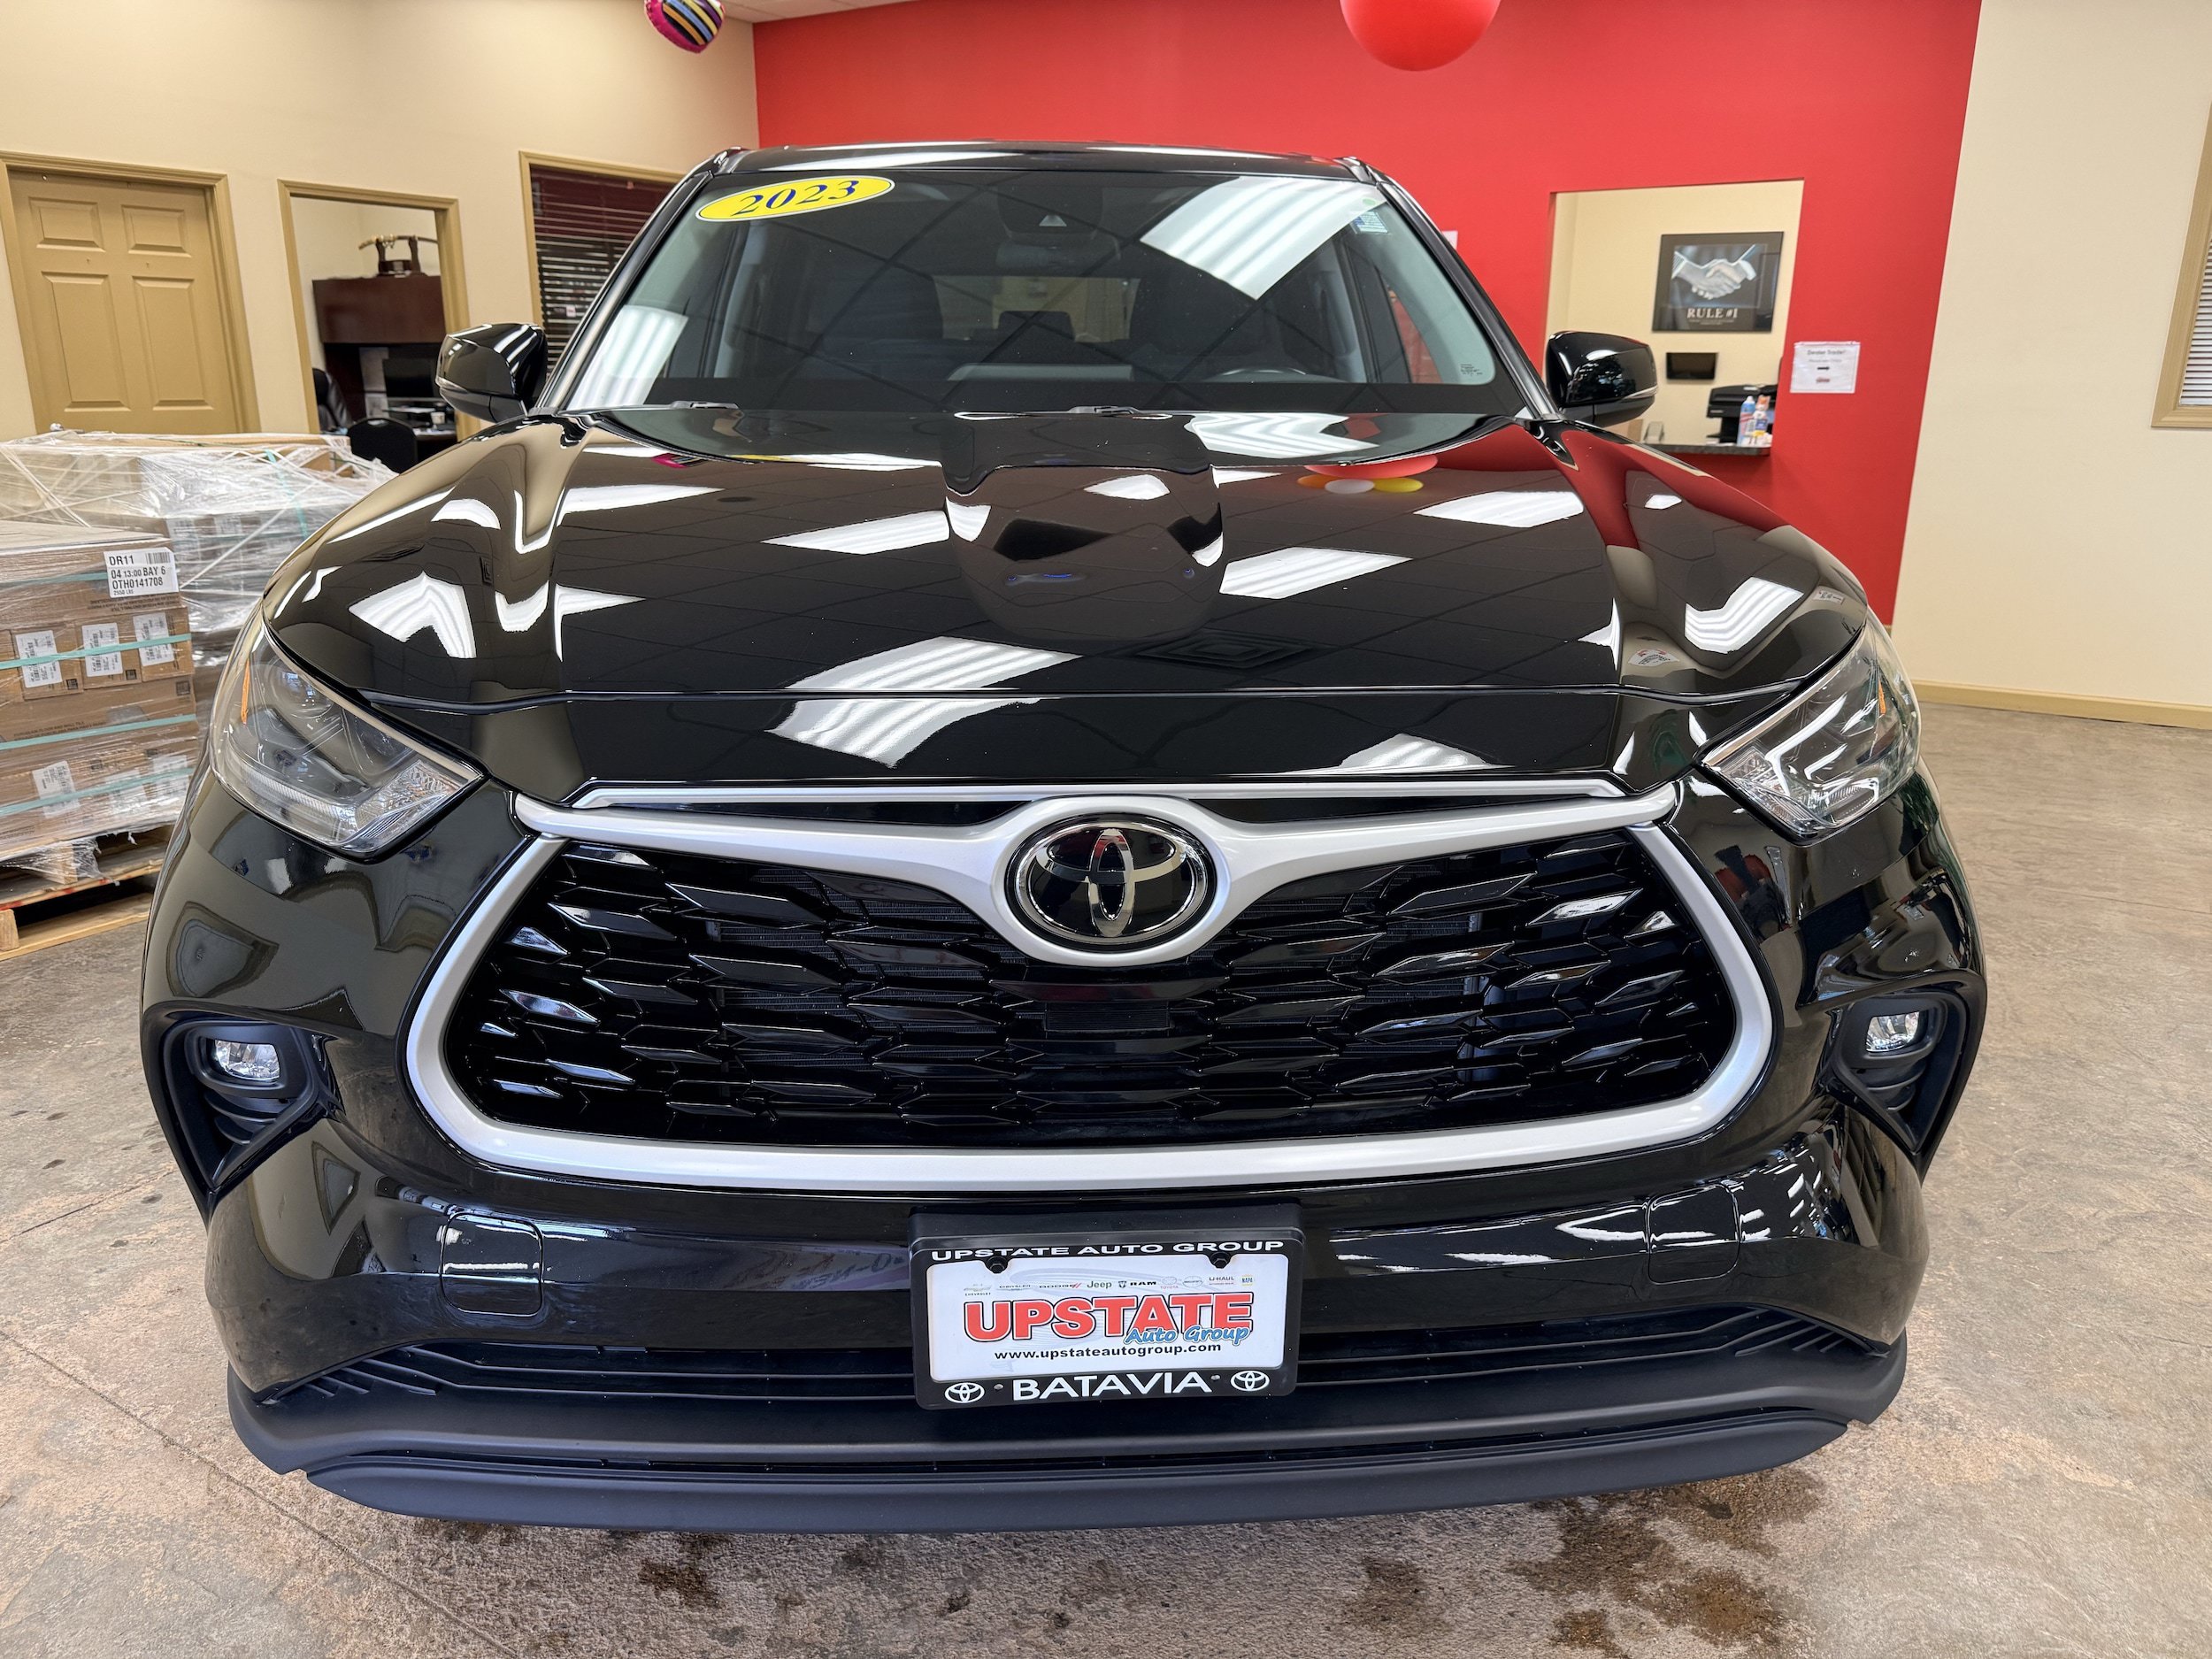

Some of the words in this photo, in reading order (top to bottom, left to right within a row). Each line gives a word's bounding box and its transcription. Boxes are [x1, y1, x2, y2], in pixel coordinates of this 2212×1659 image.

[731, 180, 859, 216] 2023
[1687, 307, 1724, 319] RULE
[1726, 307, 1738, 319] #1
[109, 555, 134, 566] DR11
[111, 570, 122, 579] 04
[124, 569, 142, 578] 13:00
[143, 566, 158, 577] BAY
[161, 566, 166, 575] 6
[932, 1247, 1070, 1261] UPSTATE
[1078, 1244, 1164, 1256] AUTO
[1172, 1240, 1284, 1253] GROUP
[1087, 1280, 1112, 1289] Jeep
[964, 1292, 1254, 1342] UPSTATE
[1125, 1327, 1177, 1344] Auto
[1183, 1325, 1250, 1346] Group
[995, 1343, 1221, 1360] www.upstateautogroup.com
[1013, 1371, 1212, 1401] BATAVIA
